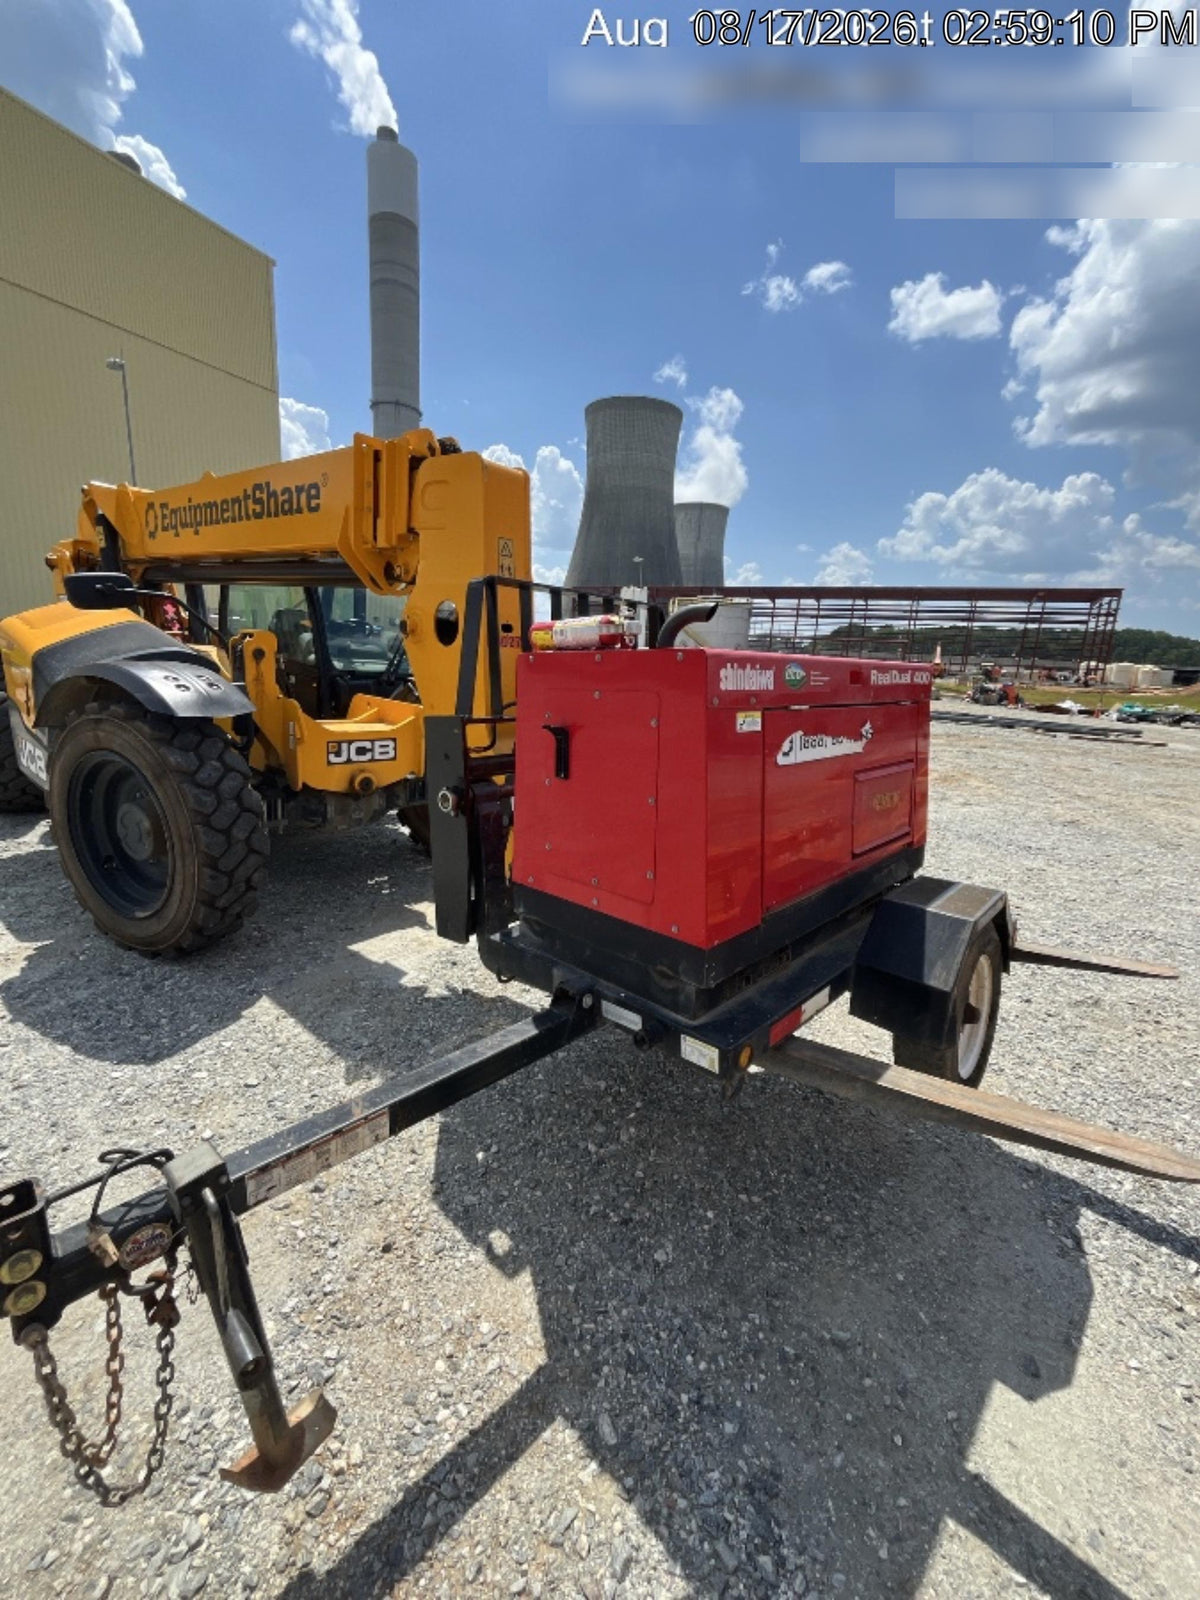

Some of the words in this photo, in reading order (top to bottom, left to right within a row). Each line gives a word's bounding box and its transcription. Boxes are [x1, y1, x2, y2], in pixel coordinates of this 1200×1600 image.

[160, 481, 321, 537] EquipmentShare
[720, 663, 775, 691] shindaiwa
[870, 669, 911, 685] RealDual
[20, 740, 47, 781] JCB
[329, 739, 396, 764] JCB
